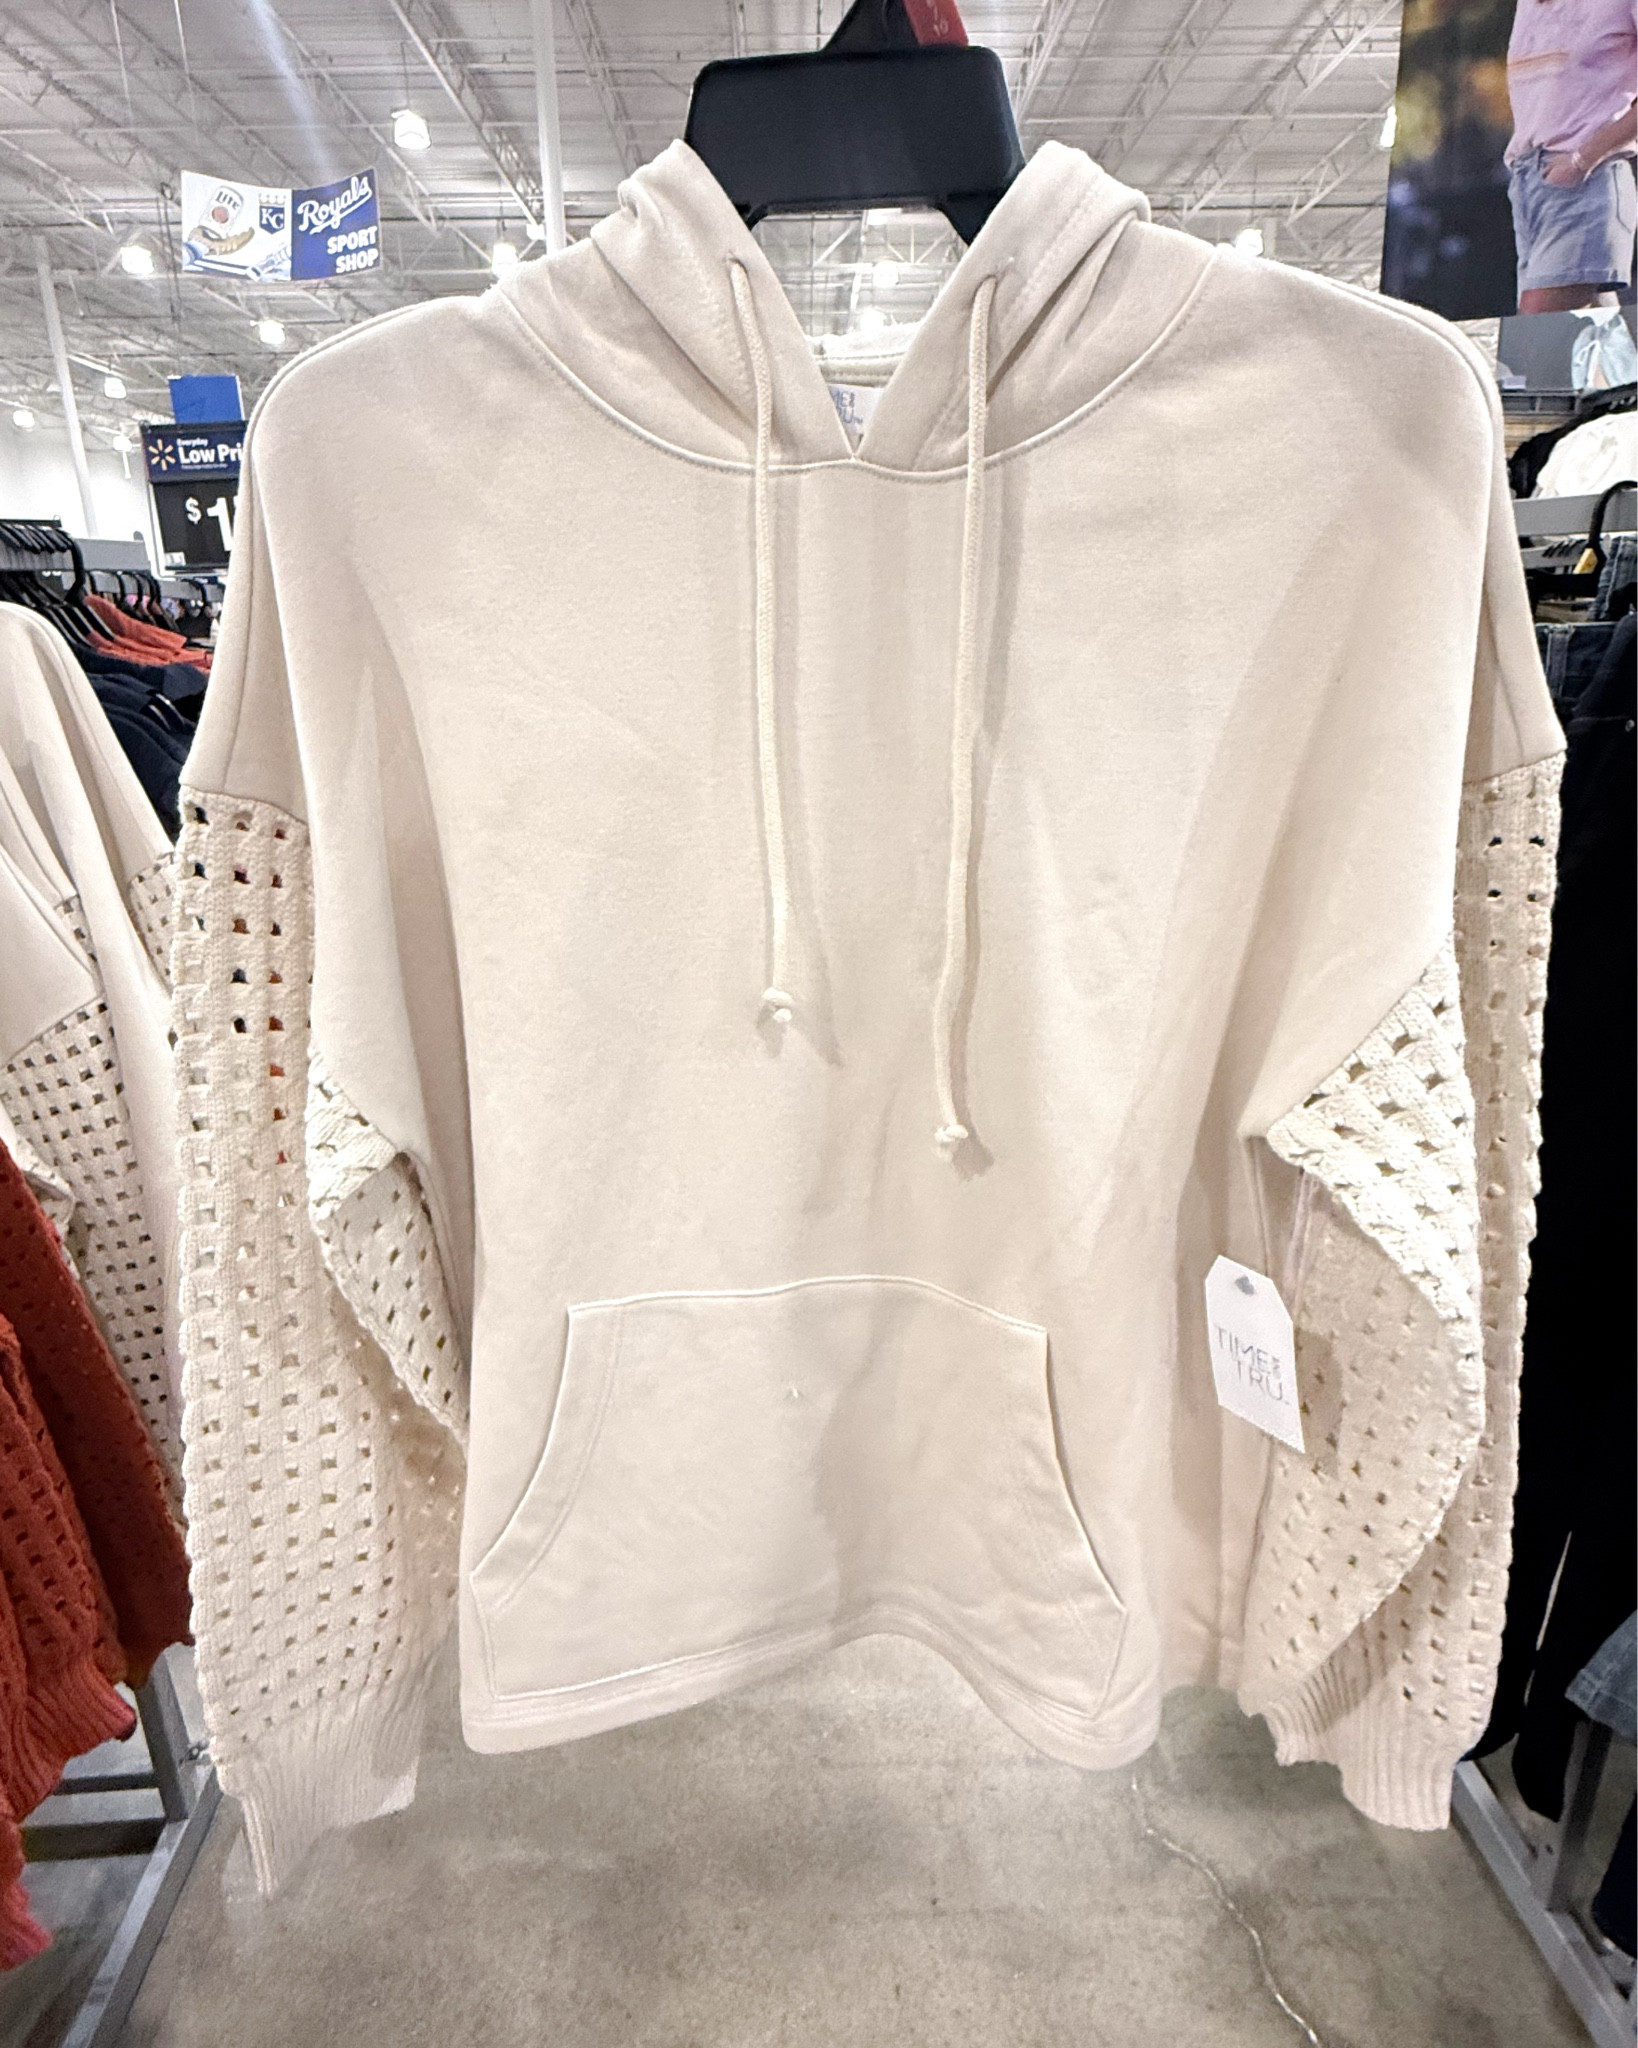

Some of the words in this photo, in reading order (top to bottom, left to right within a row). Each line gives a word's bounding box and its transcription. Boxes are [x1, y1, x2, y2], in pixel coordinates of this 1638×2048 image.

[297, 176, 373, 234] Royals
[261, 208, 284, 229] KC
[327, 226, 378, 254] SPORT
[336, 249, 379, 274] SHOP
[178, 446, 215, 464] Low
